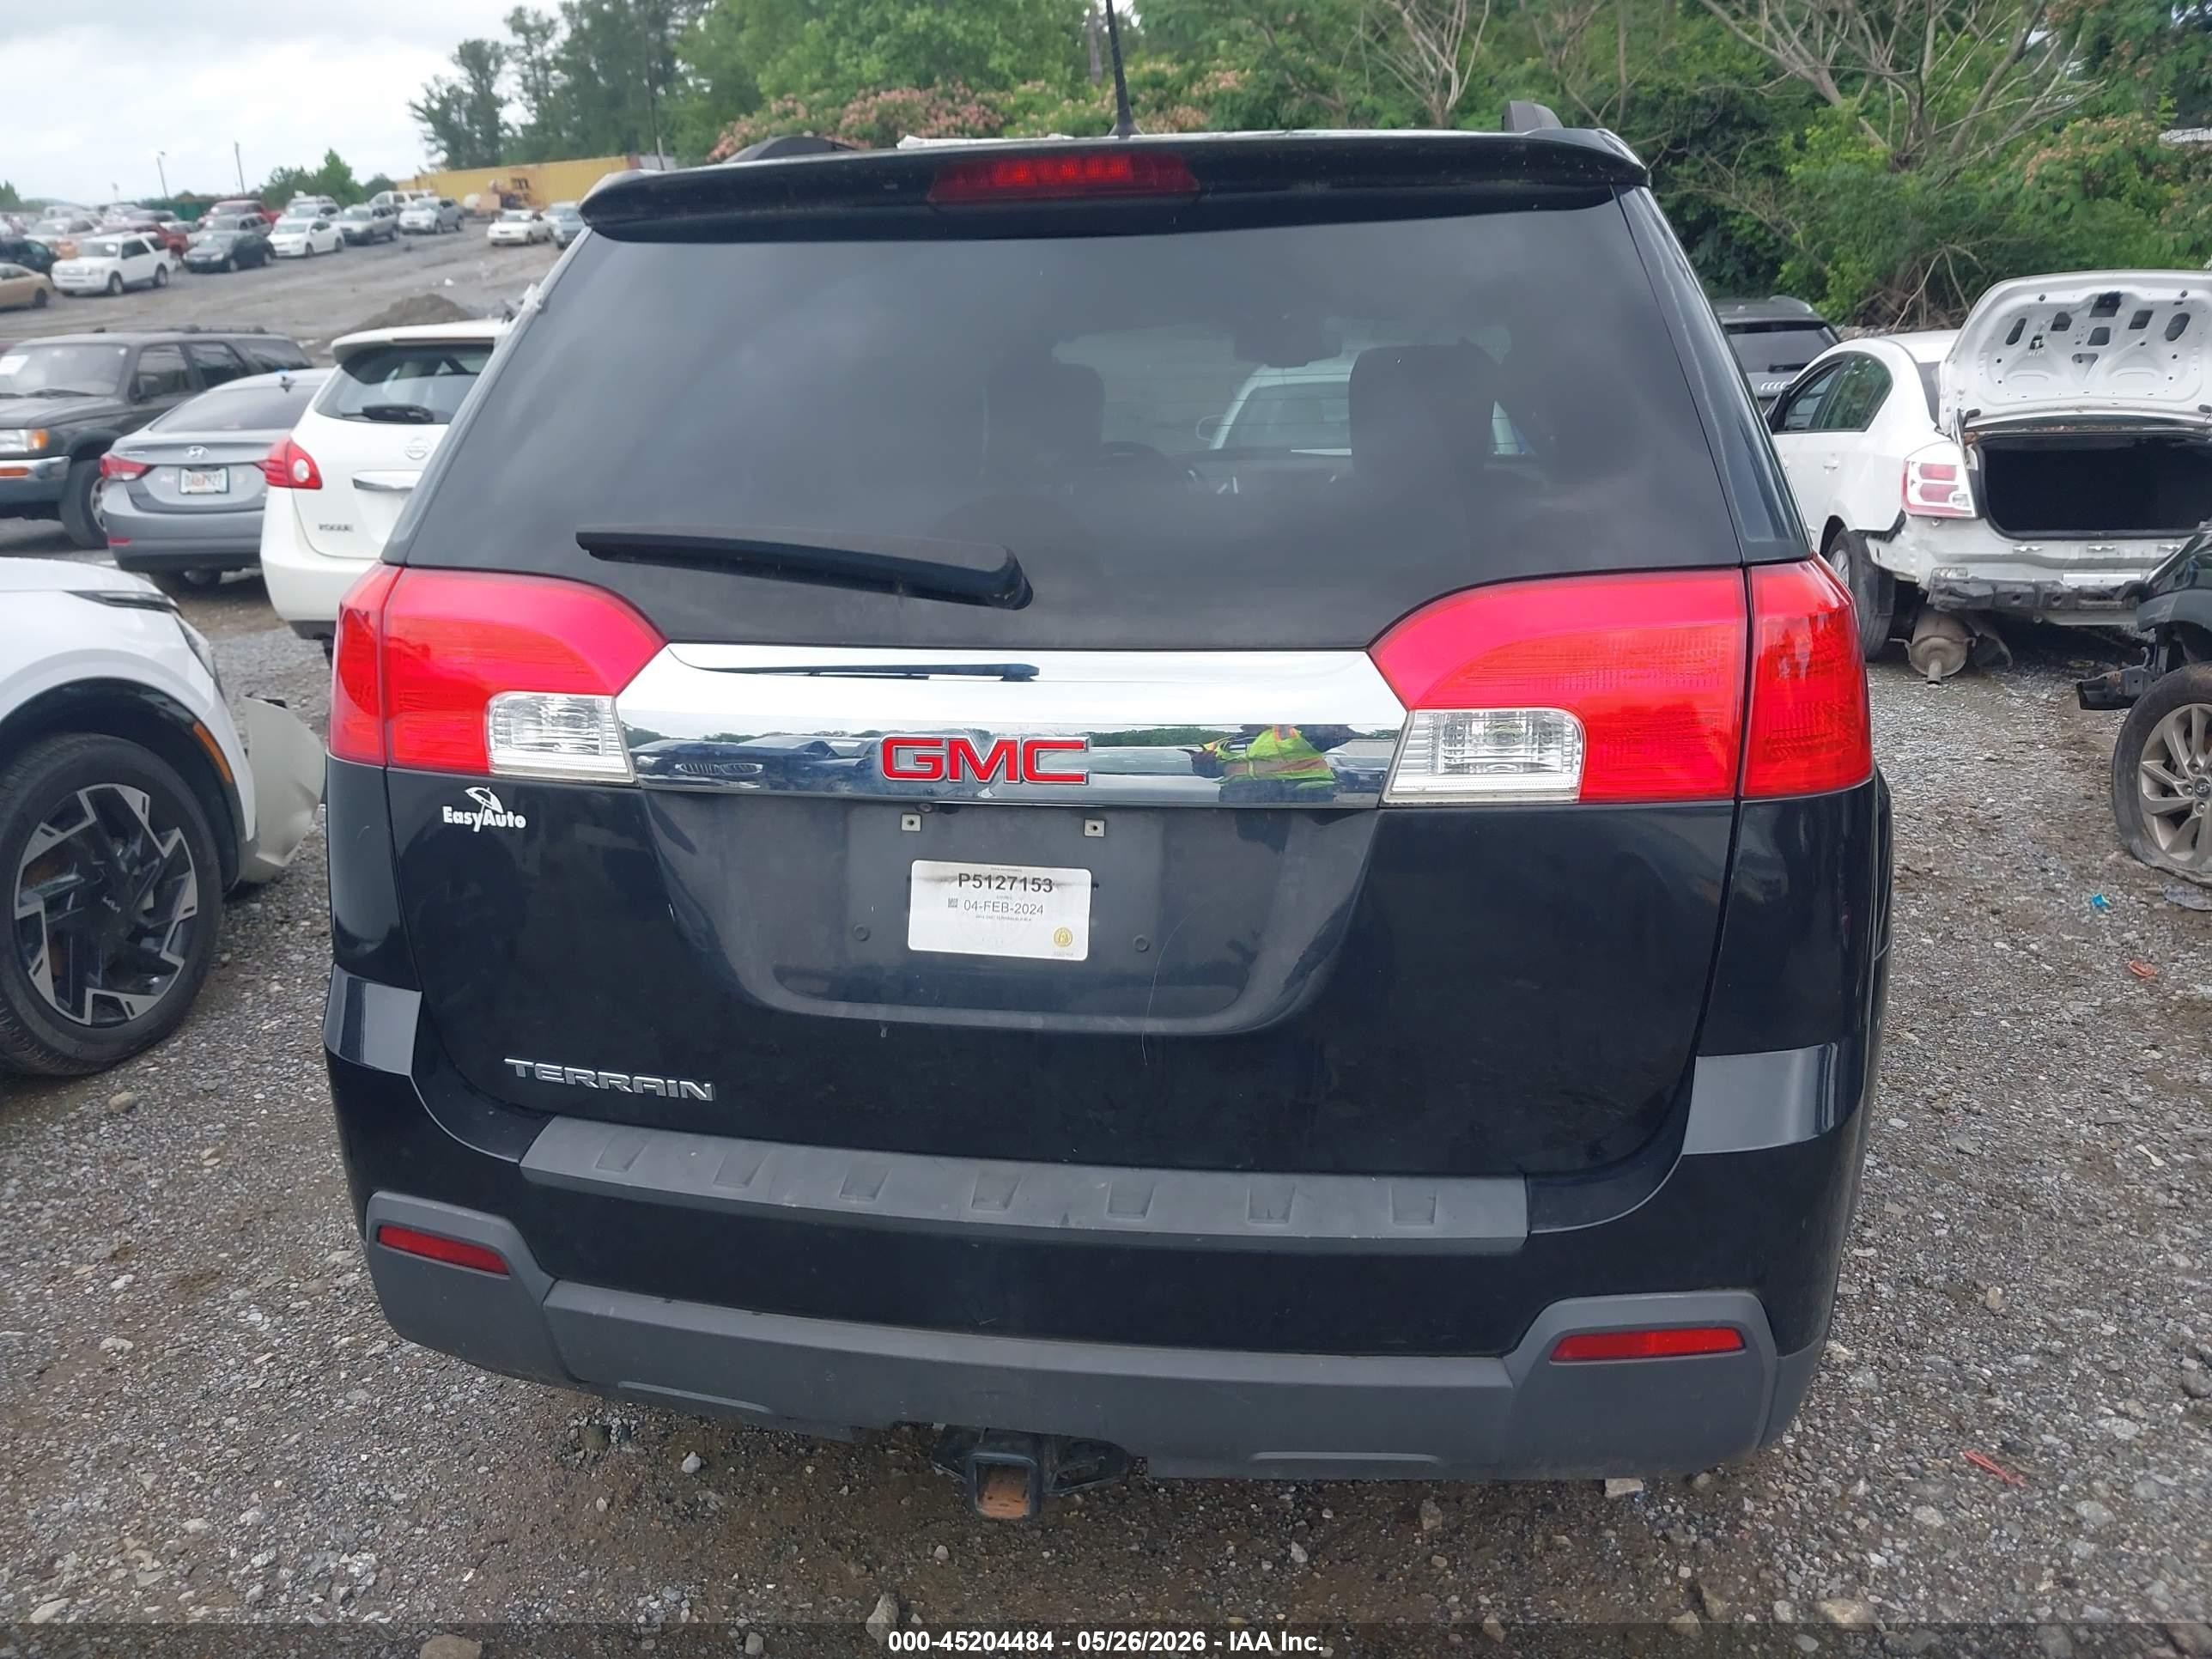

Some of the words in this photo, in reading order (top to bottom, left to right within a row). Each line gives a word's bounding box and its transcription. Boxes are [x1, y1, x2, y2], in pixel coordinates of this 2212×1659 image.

[880, 734, 1090, 785] GMC
[442, 805, 526, 832] EasyAuto
[958, 872, 1054, 893] P5127153
[963, 899, 1044, 915] 04-FEB-2024
[504, 1058, 715, 1101] TERRAIN
